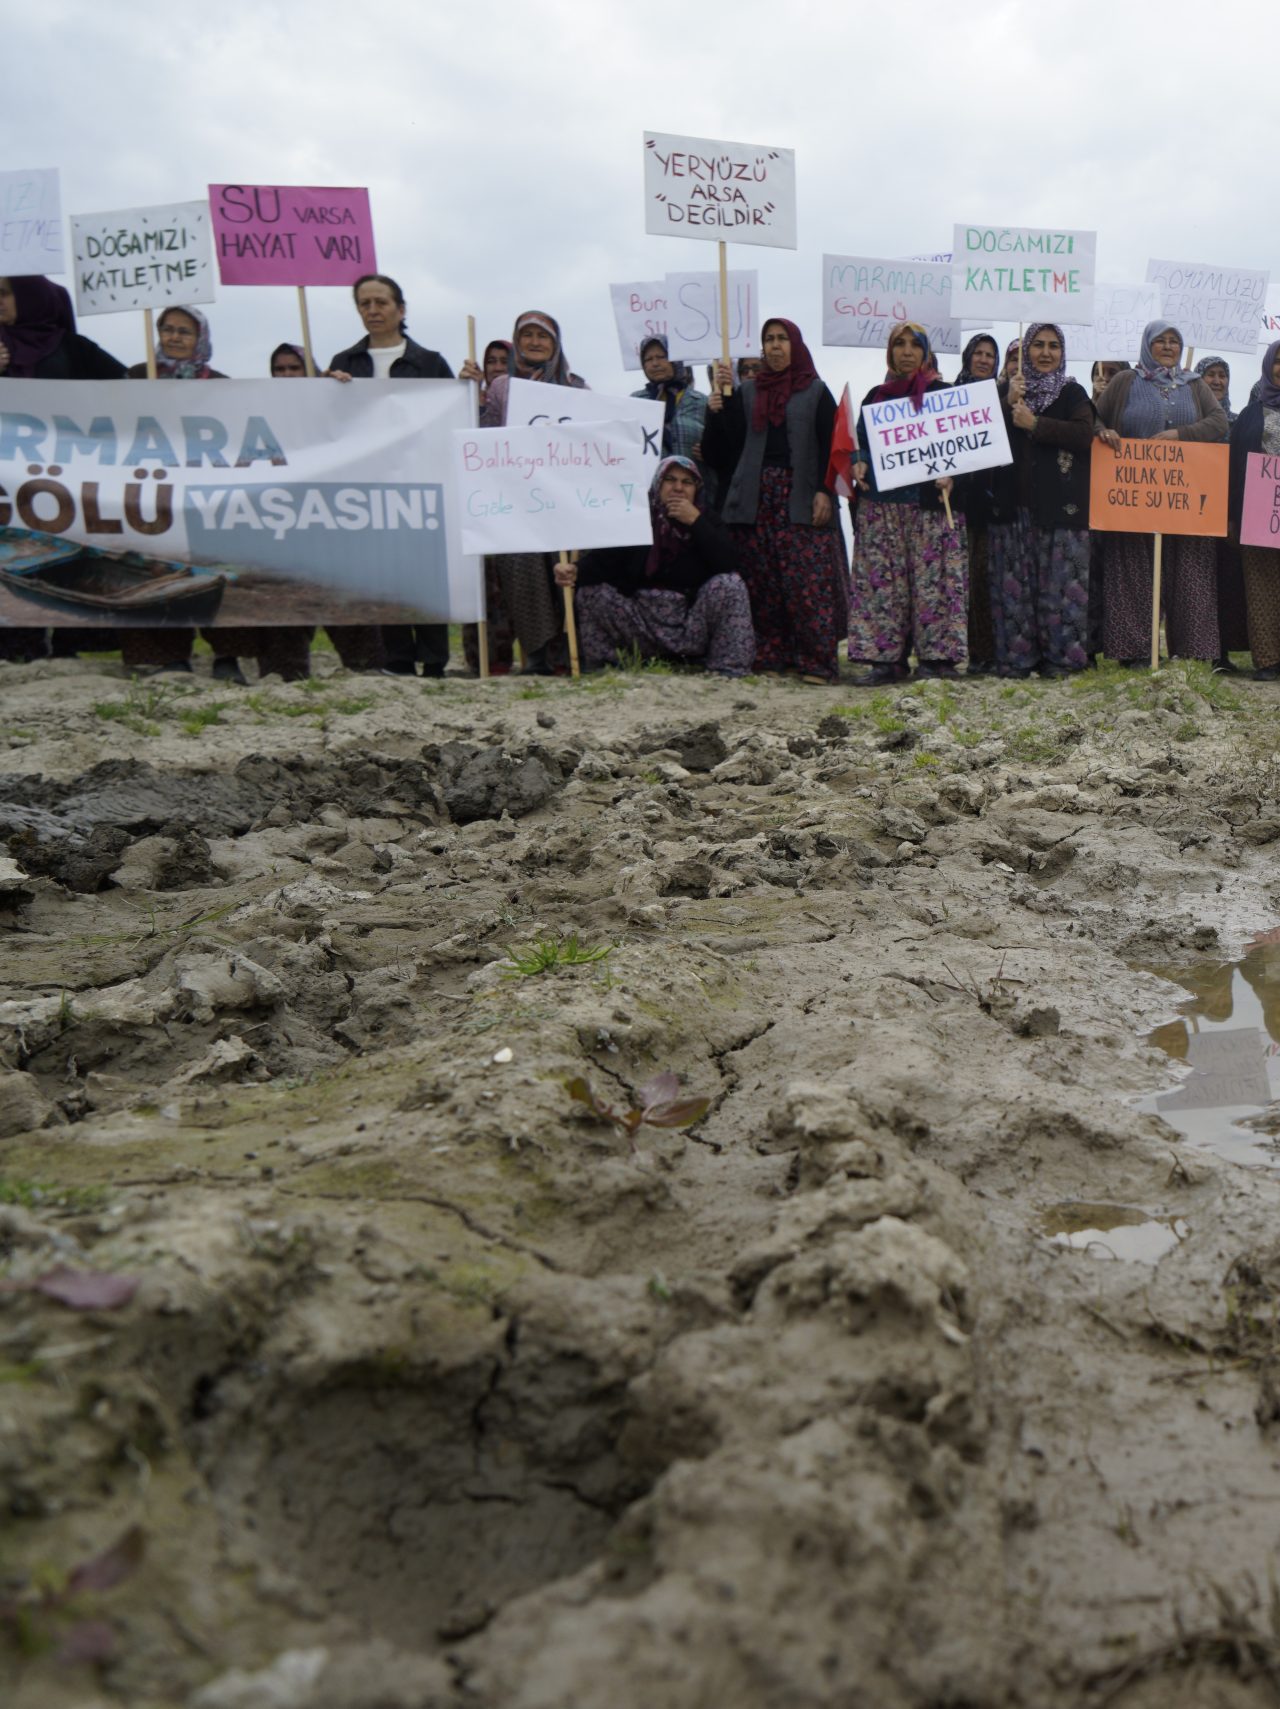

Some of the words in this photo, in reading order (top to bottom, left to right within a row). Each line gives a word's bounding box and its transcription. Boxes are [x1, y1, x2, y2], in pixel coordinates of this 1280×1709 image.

[219, 185, 281, 223] SU
[293, 207, 356, 225] VARSA
[690, 184, 747, 204] ARSA
[86, 228, 187, 258] DOĞAMIZI
[221, 233, 296, 259] HAYAT
[966, 228, 1075, 254] DOĞAMIZI
[82, 259, 197, 292] KATLETME
[965, 267, 1081, 293] KATLETME
[879, 421, 928, 446] TERK
[935, 407, 992, 434] ETMEK
[1115, 466, 1158, 486] KULAK
[0, 464, 173, 536] ÖLÜ
[189, 488, 439, 540] YAŞASIN!
[1108, 489, 1139, 507] GÖLE
[1145, 491, 1162, 508] SU
[1168, 492, 1190, 510] VER
